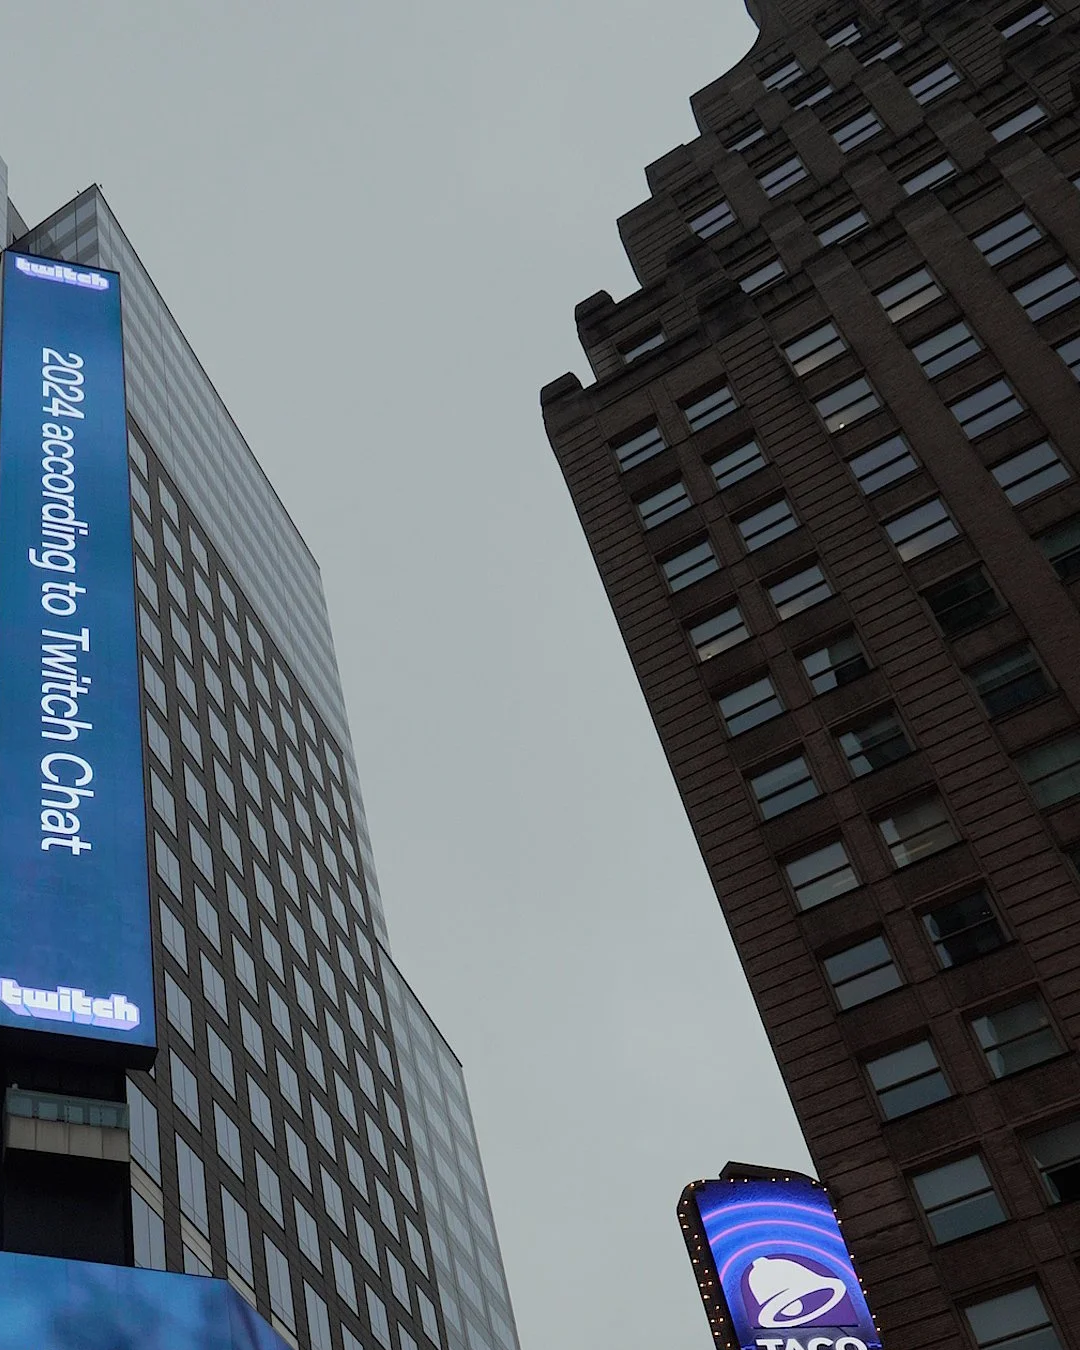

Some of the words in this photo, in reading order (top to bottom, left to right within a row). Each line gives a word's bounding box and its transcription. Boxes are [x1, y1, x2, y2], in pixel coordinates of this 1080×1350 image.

[16, 257, 109, 290] twitch
[41, 347, 85, 419] 2024
[29, 423, 88, 574] according
[41, 580, 87, 616] to
[41, 627, 94, 742] Twitch
[40, 752, 94, 856] Chat
[0, 976, 140, 1031] twitch
